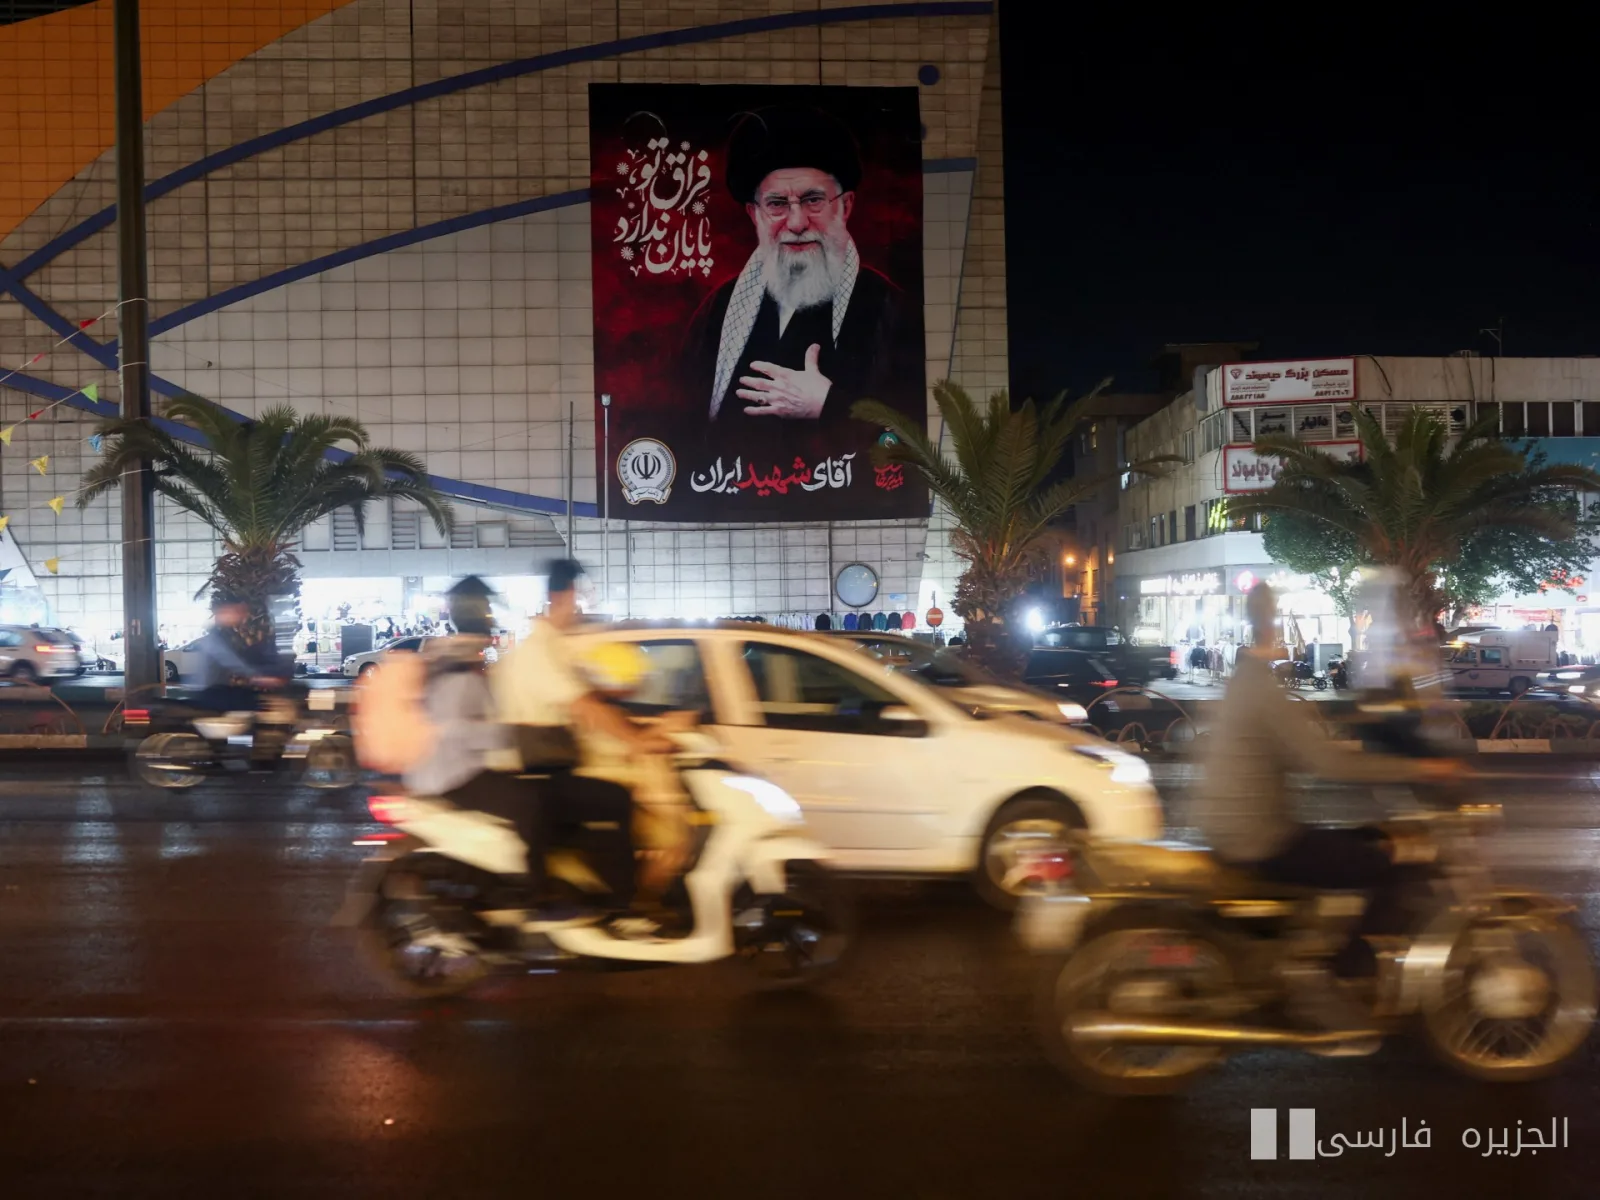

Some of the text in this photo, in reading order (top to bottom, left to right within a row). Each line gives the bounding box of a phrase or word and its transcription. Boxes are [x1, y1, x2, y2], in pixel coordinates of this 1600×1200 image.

[650, 150, 711, 212] فراق
[613, 201, 714, 276] پایان ندارد
[690, 451, 857, 496] آقای شهید ایران
